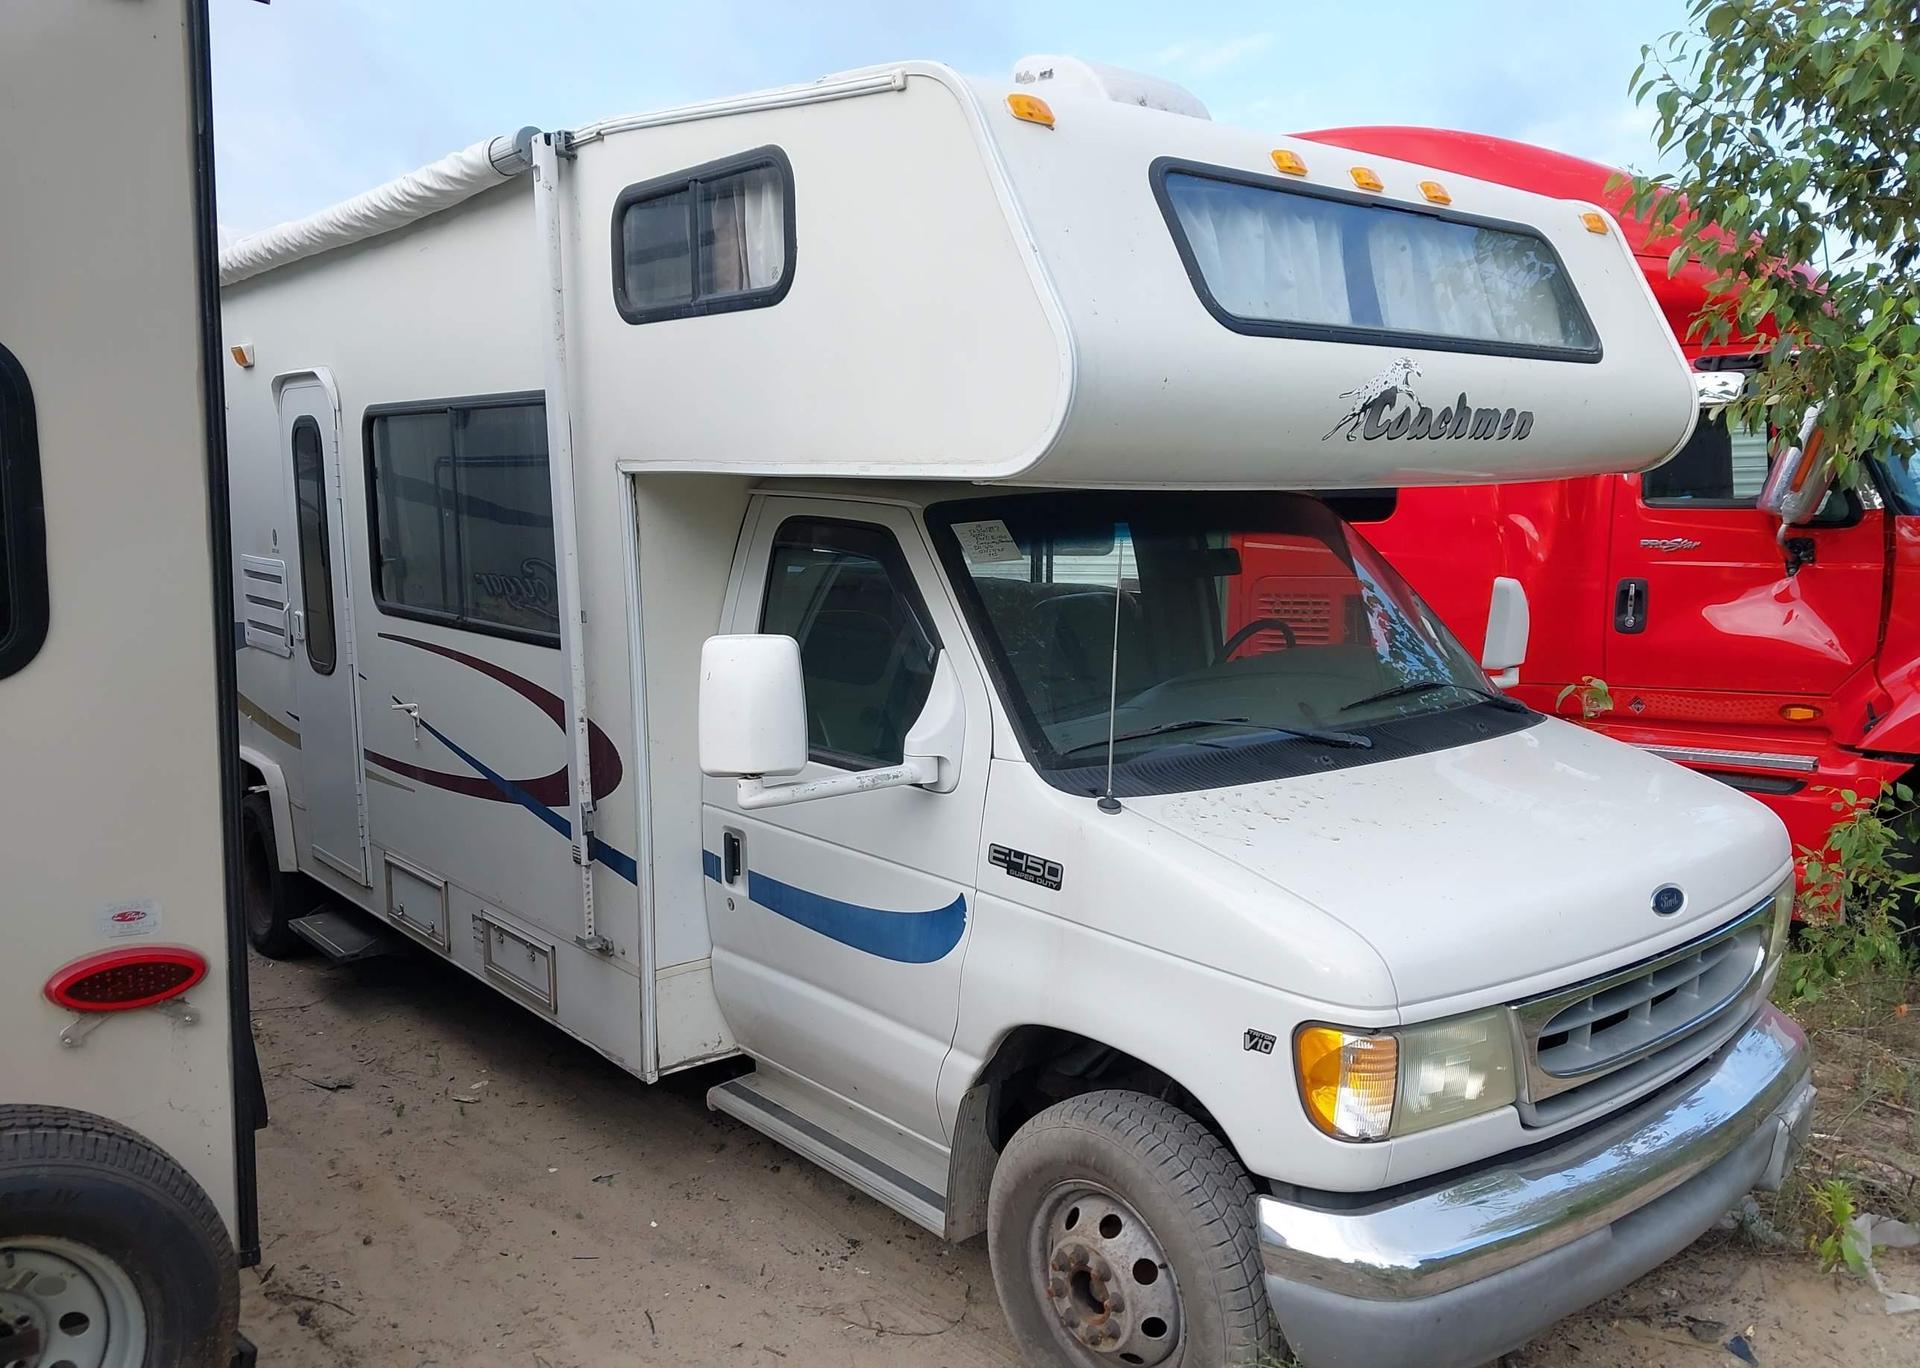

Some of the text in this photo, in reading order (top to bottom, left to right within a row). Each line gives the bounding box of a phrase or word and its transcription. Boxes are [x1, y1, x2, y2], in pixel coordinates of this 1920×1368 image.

[1363, 386, 1534, 441] Coachmen
[989, 844, 1063, 883] E-450
[1009, 868, 1058, 889] SUPER DUTY
[1244, 1033, 1273, 1053] V10
[1249, 1029, 1276, 1042] TRITON
